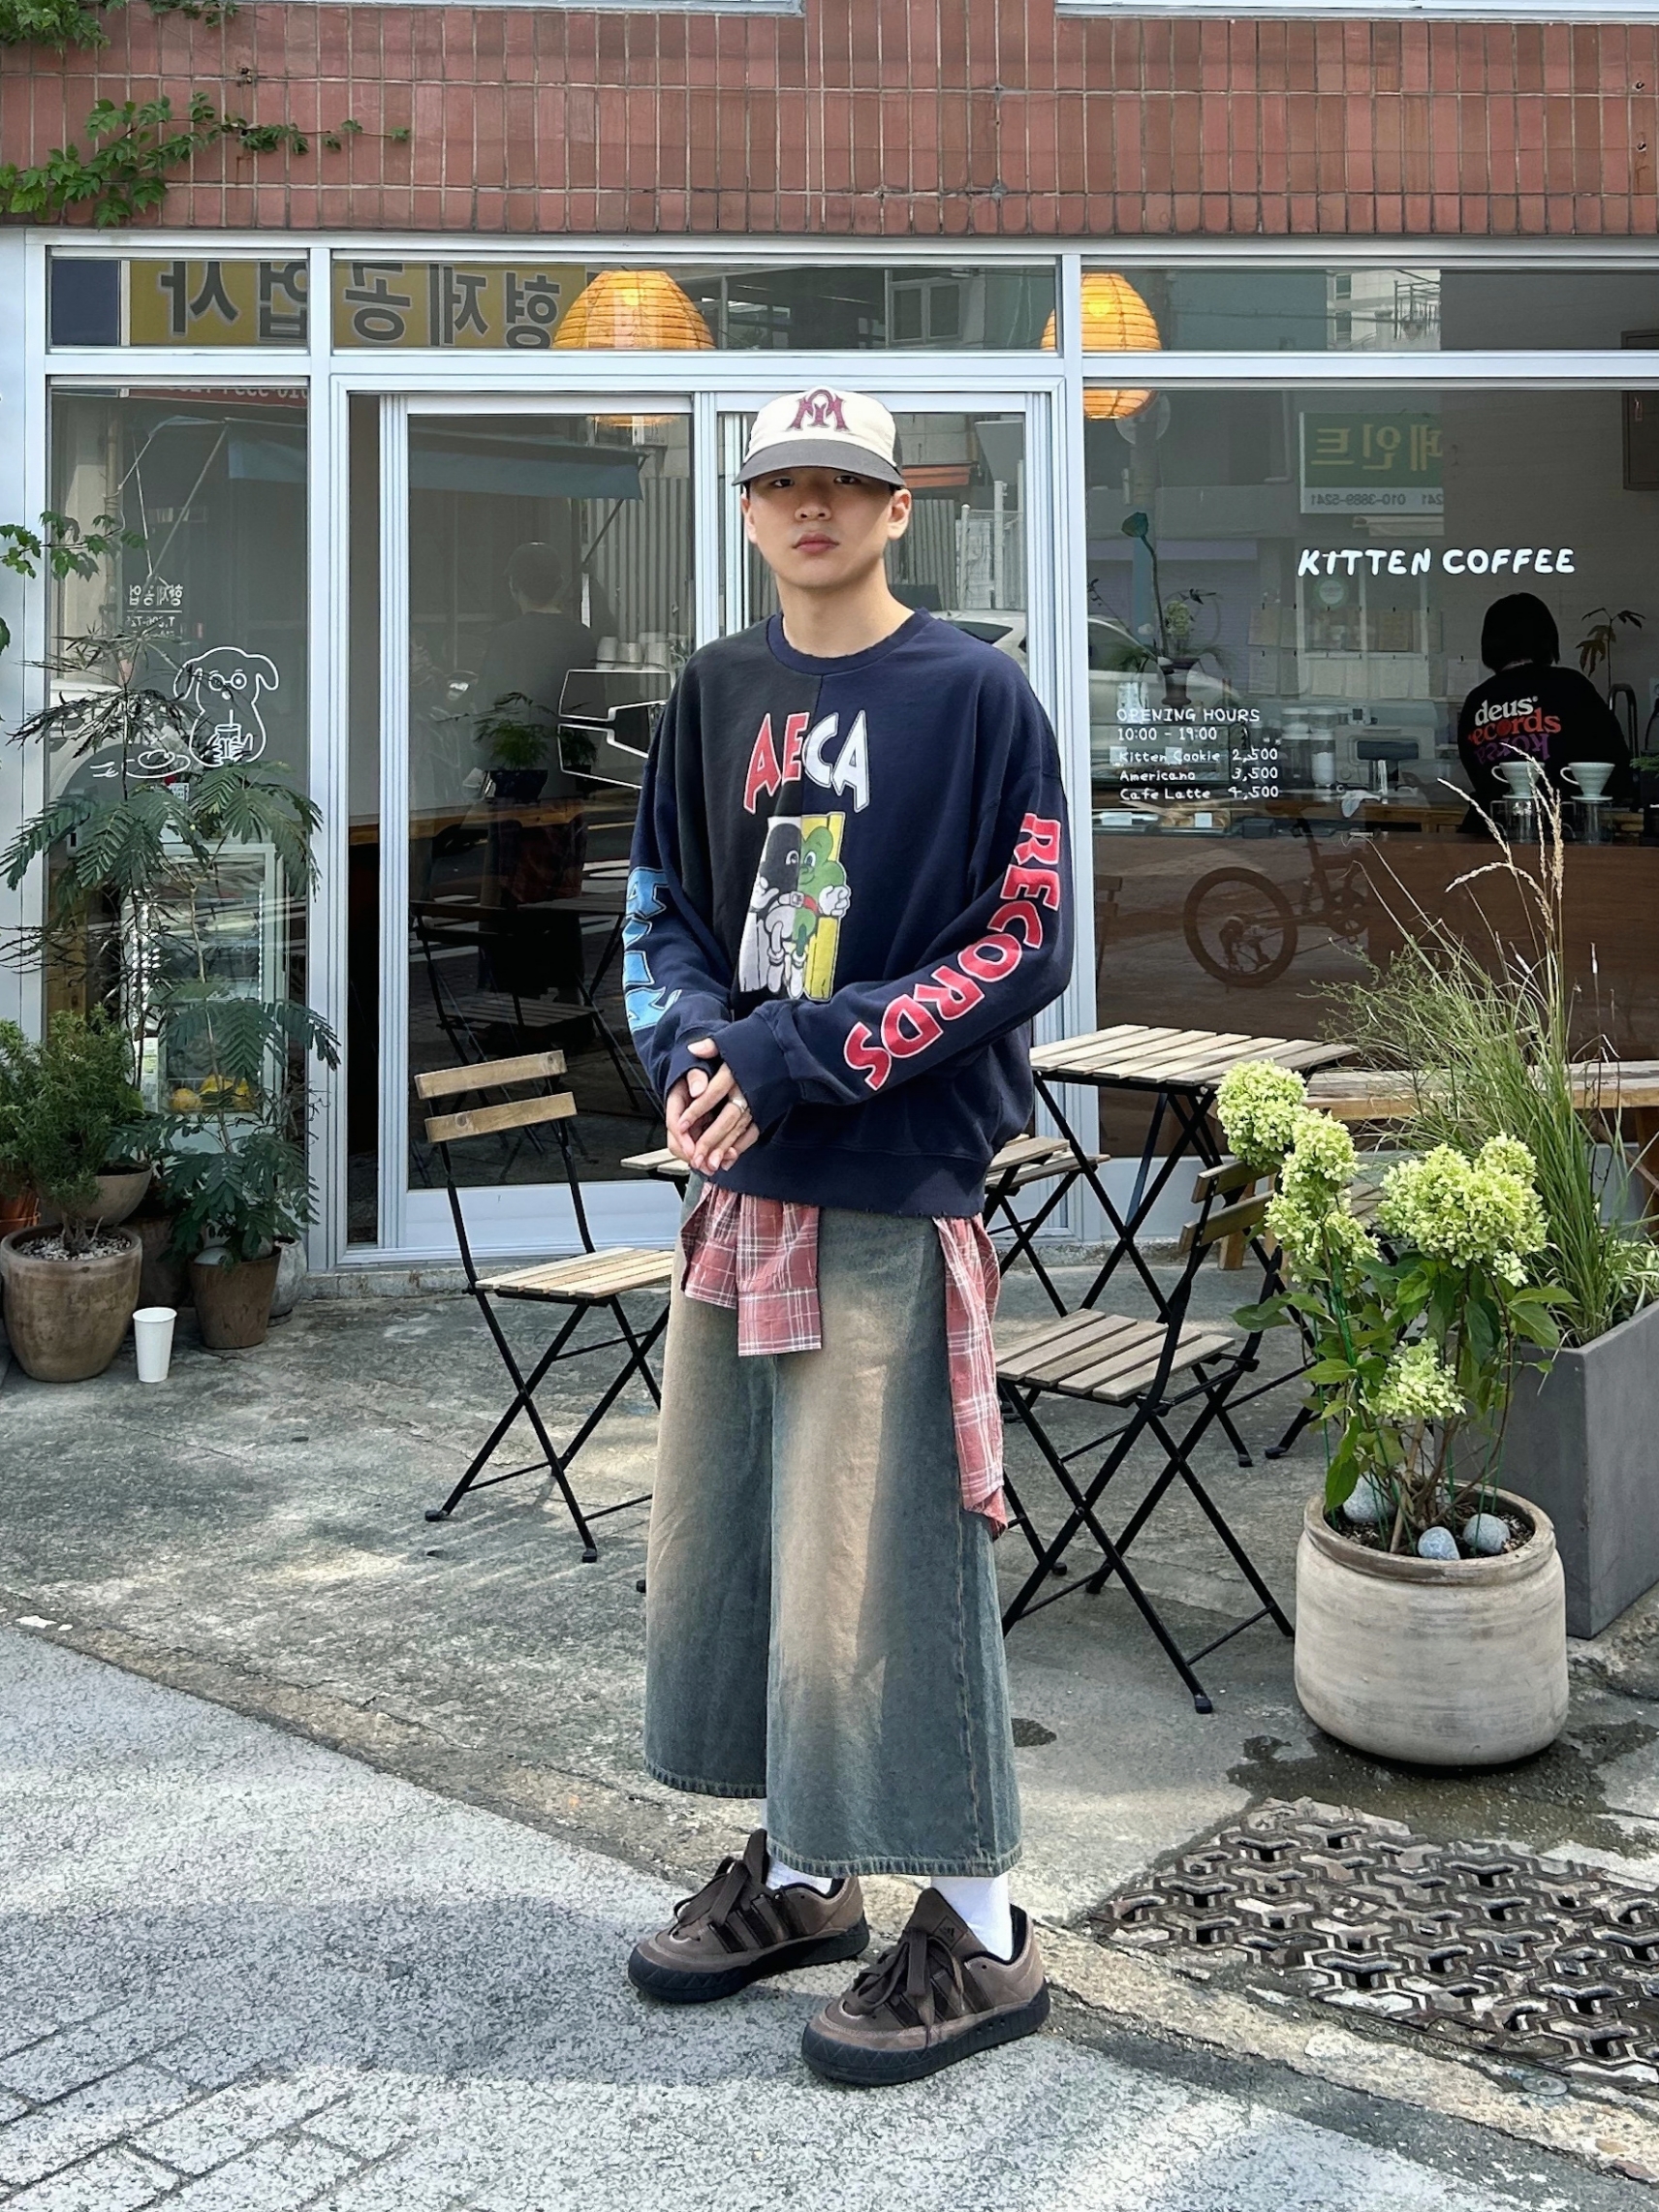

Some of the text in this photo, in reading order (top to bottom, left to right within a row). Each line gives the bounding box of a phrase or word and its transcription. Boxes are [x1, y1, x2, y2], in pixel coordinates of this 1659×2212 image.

[1298, 547, 1576, 576] KITTEN COFFEE
[1116, 708, 1261, 723] OPENING HOURS
[1117, 728, 1157, 740] 10:00
[1178, 727, 1217, 741] 19:00
[743, 708, 869, 814] AECA
[1118, 746, 1278, 763] Kitten Cookie 2,500
[1119, 765, 1278, 782] Americano 3,500
[1120, 785, 1279, 801] Cafe Latte 4,500
[843, 812, 1061, 1091] RECORDS
